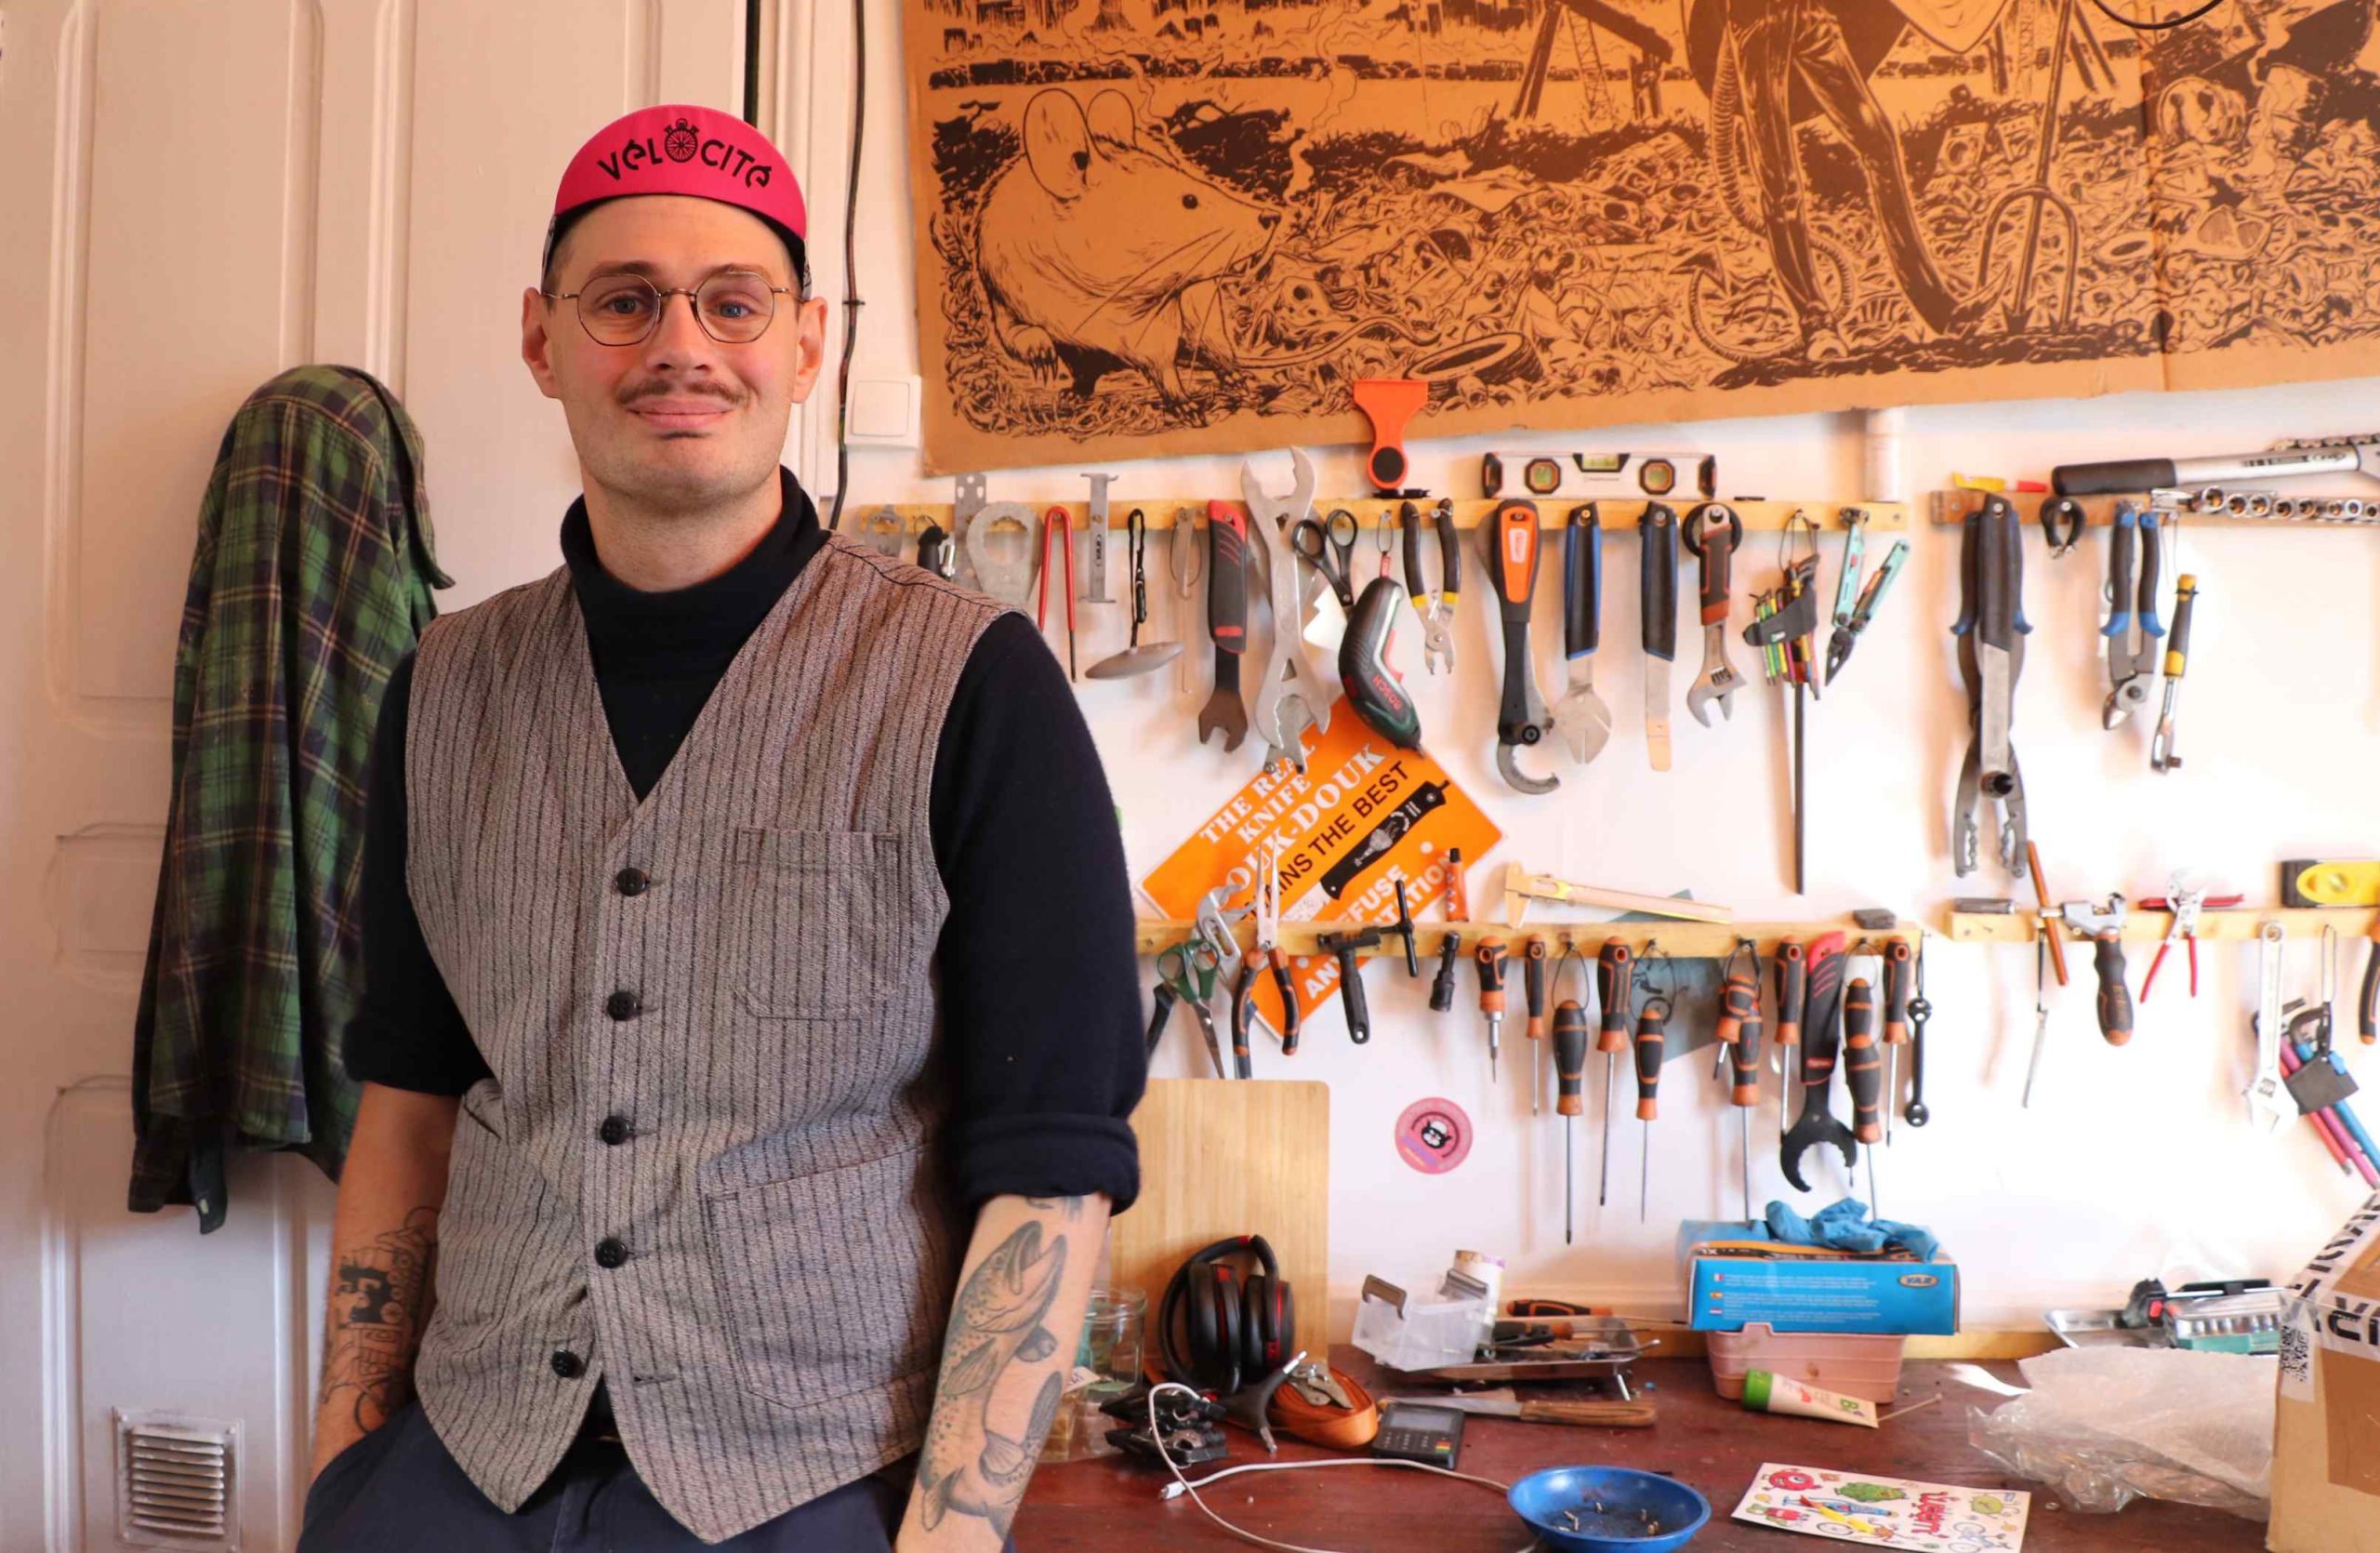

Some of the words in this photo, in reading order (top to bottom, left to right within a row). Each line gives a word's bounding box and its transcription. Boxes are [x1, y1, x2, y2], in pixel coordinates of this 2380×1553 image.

[1372, 674, 1403, 710] BOSCH
[1199, 796, 1253, 844] THE
[1236, 775, 1312, 844] KNIFE
[1308, 814, 1355, 856] THE
[1353, 761, 1408, 817] BEST
